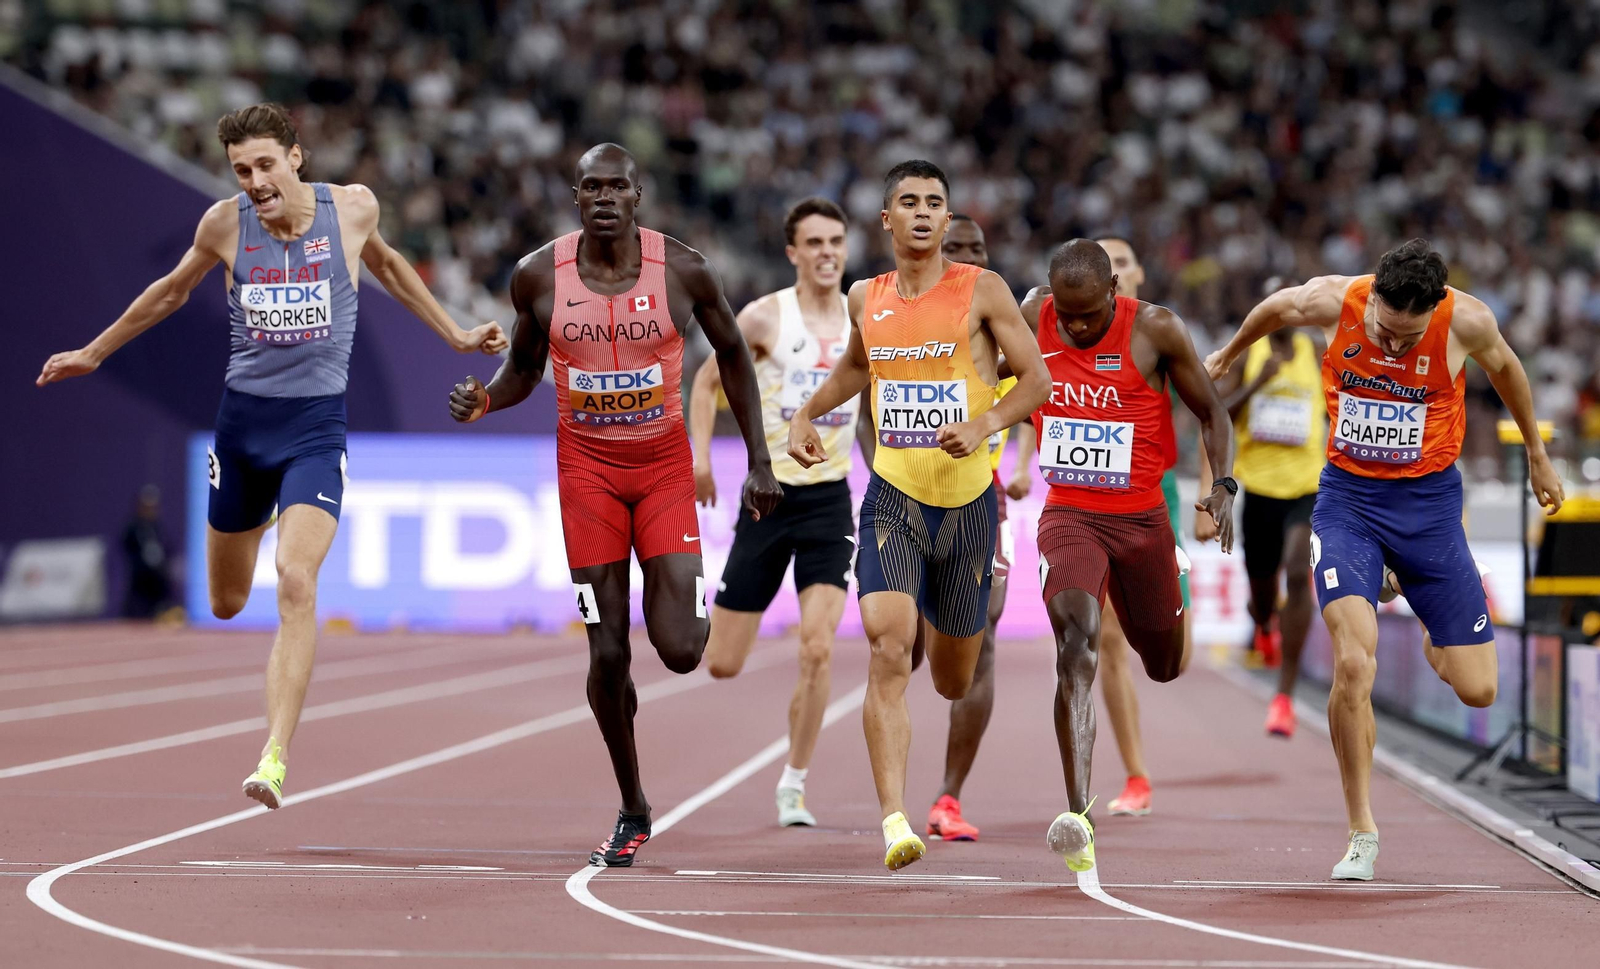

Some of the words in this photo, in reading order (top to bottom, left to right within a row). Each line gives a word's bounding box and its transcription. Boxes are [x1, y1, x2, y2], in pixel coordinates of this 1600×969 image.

[250, 263, 322, 284] GREAT
[265, 285, 323, 304] TDK
[249, 305, 327, 328] CRORKEN
[563, 320, 662, 342] CANADA
[869, 340, 957, 361] ESPAÑA
[592, 368, 656, 390] TDK
[583, 390, 653, 412] AROP
[897, 383, 960, 403] TDK
[1049, 381, 1122, 408] ENYA
[882, 407, 963, 429] ATTAOUI
[1358, 401, 1419, 422] TDK
[1064, 421, 1126, 445] TDK
[1341, 418, 1419, 446] CHAPPLE
[1056, 445, 1111, 468] LOTI
[577, 591, 590, 619] 4
